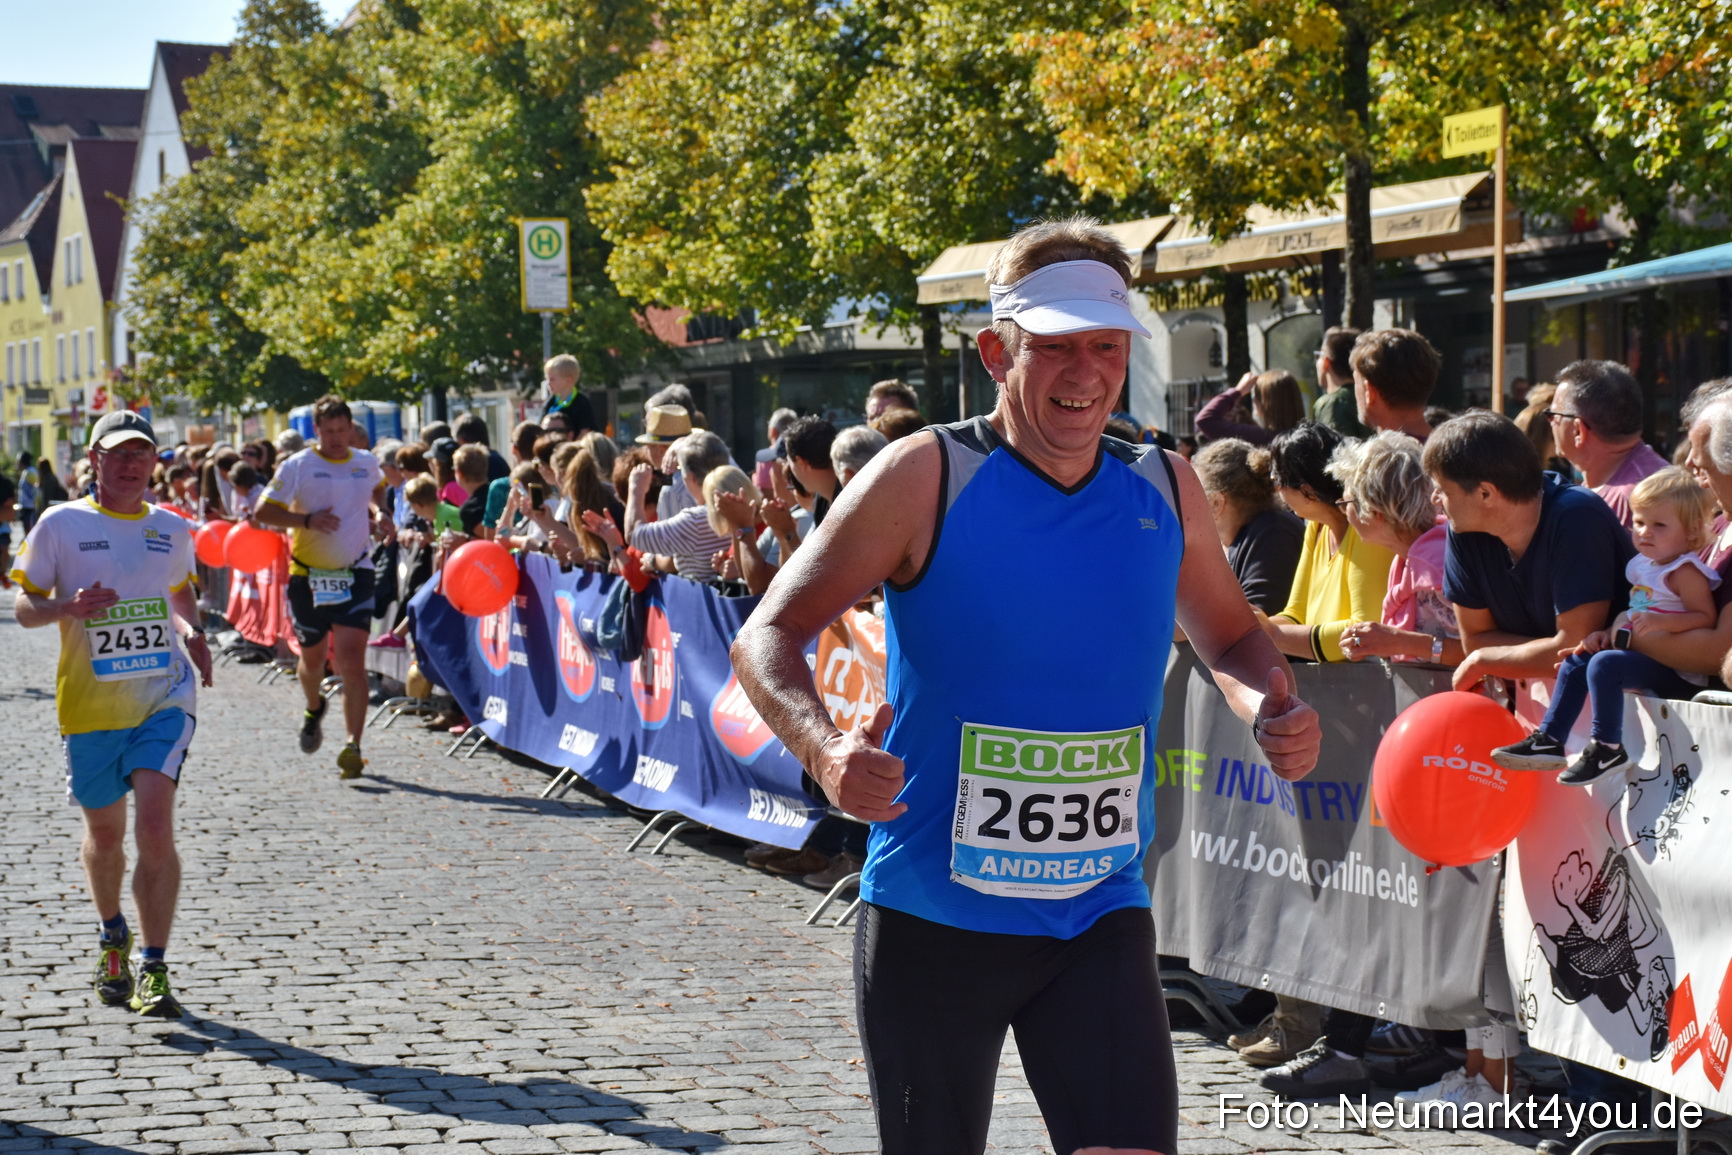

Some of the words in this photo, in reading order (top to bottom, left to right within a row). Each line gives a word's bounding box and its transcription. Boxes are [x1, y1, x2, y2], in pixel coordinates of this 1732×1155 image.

[1455, 123, 1497, 143] Toiletten
[96, 625, 165, 654] 2432
[112, 656, 158, 671] KLAUS
[977, 734, 1130, 776] BOCK
[1423, 745, 1508, 785] RÖDL
[1215, 757, 1363, 823] INDUSTRY
[1468, 774, 1506, 792] energie
[747, 788, 770, 821] GET
[978, 787, 1121, 842] 2636
[979, 855, 1113, 880] ANDREAS
